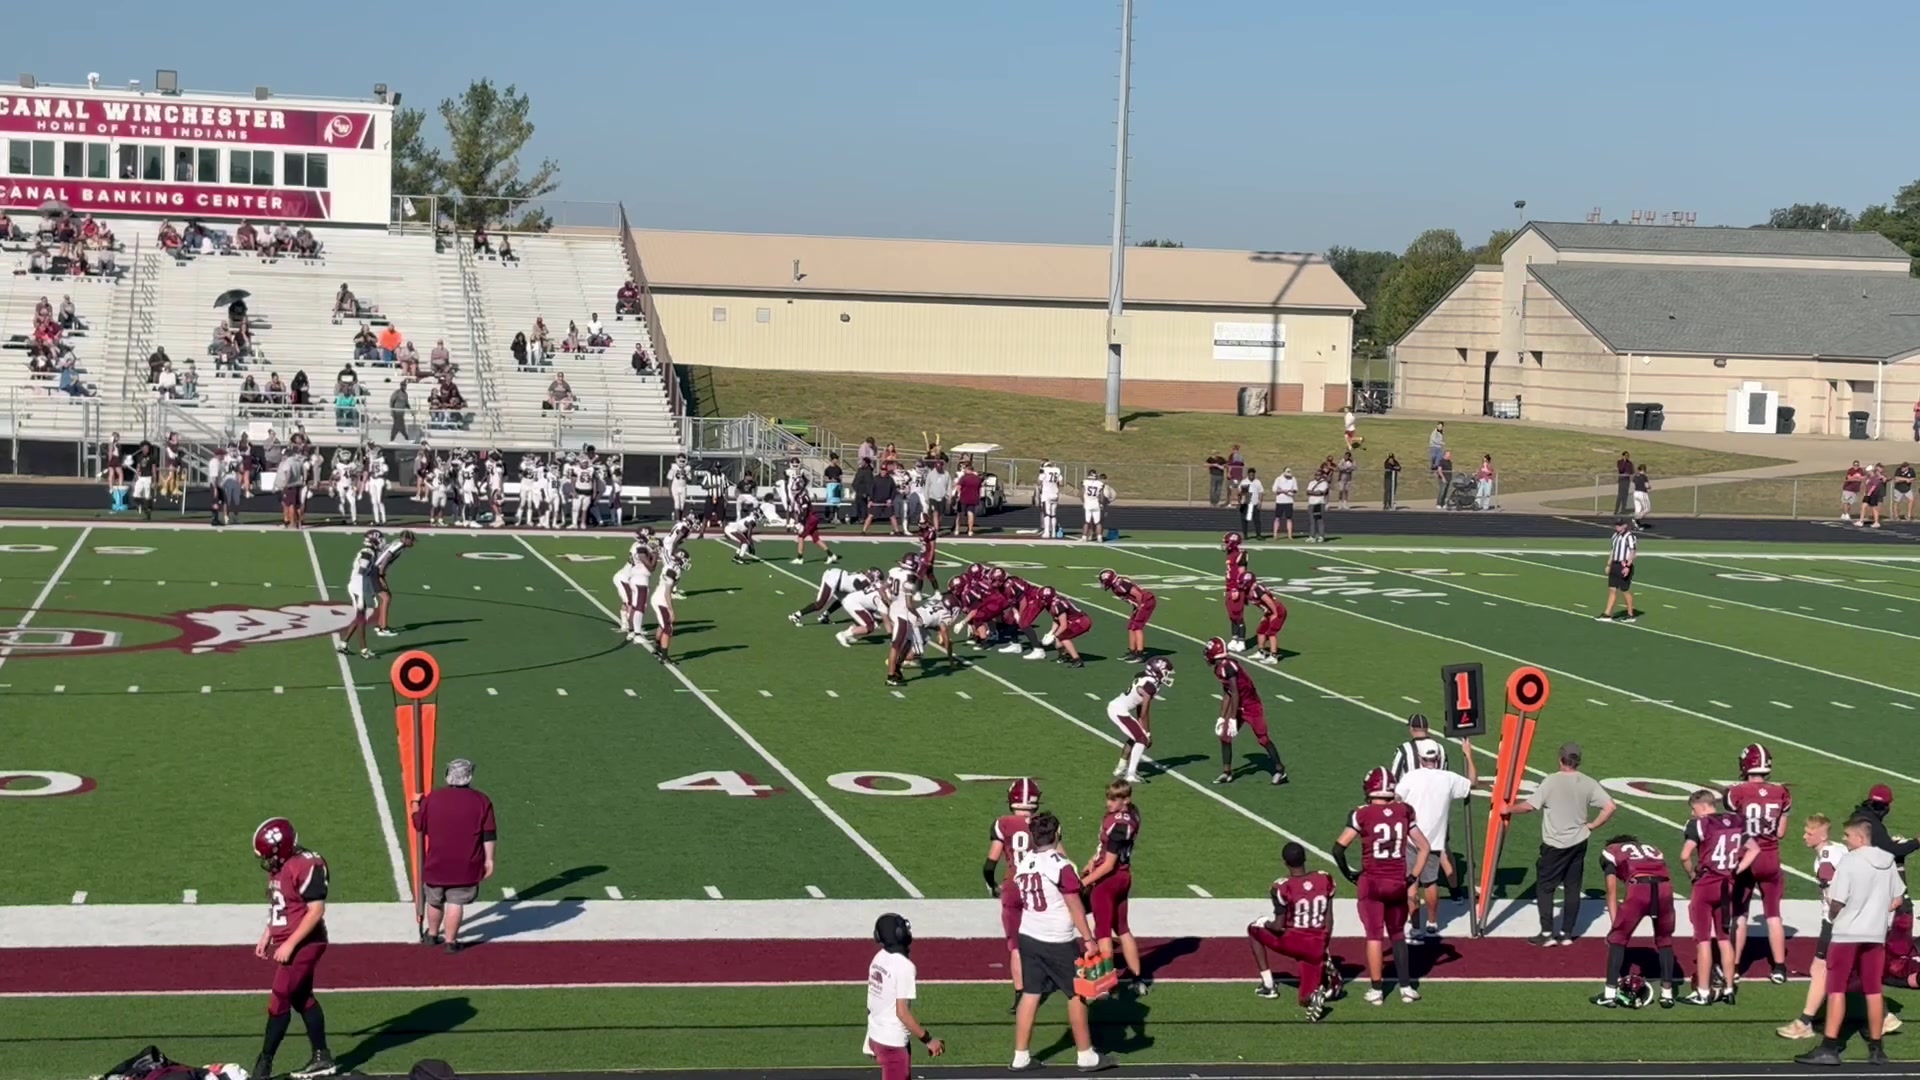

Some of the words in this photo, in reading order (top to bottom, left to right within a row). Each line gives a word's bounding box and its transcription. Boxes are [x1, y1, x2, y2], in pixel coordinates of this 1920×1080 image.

[0, 97, 90, 119] CANAL
[102, 101, 286, 129] WINCHESTER
[37, 120, 86, 132] HOME
[97, 124, 118, 134] OF
[130, 125, 162, 136] THE
[173, 127, 248, 140] INDIANS
[82, 188, 184, 206] BANKING
[196, 193, 284, 210] CENTER
[1087, 487, 1098, 497] 57
[1454, 671, 1473, 712] 1
[1745, 803, 1780, 837] 85
[1372, 822, 1403, 860] 21
[1711, 834, 1741, 871] 42
[1017, 872, 1048, 913] 70
